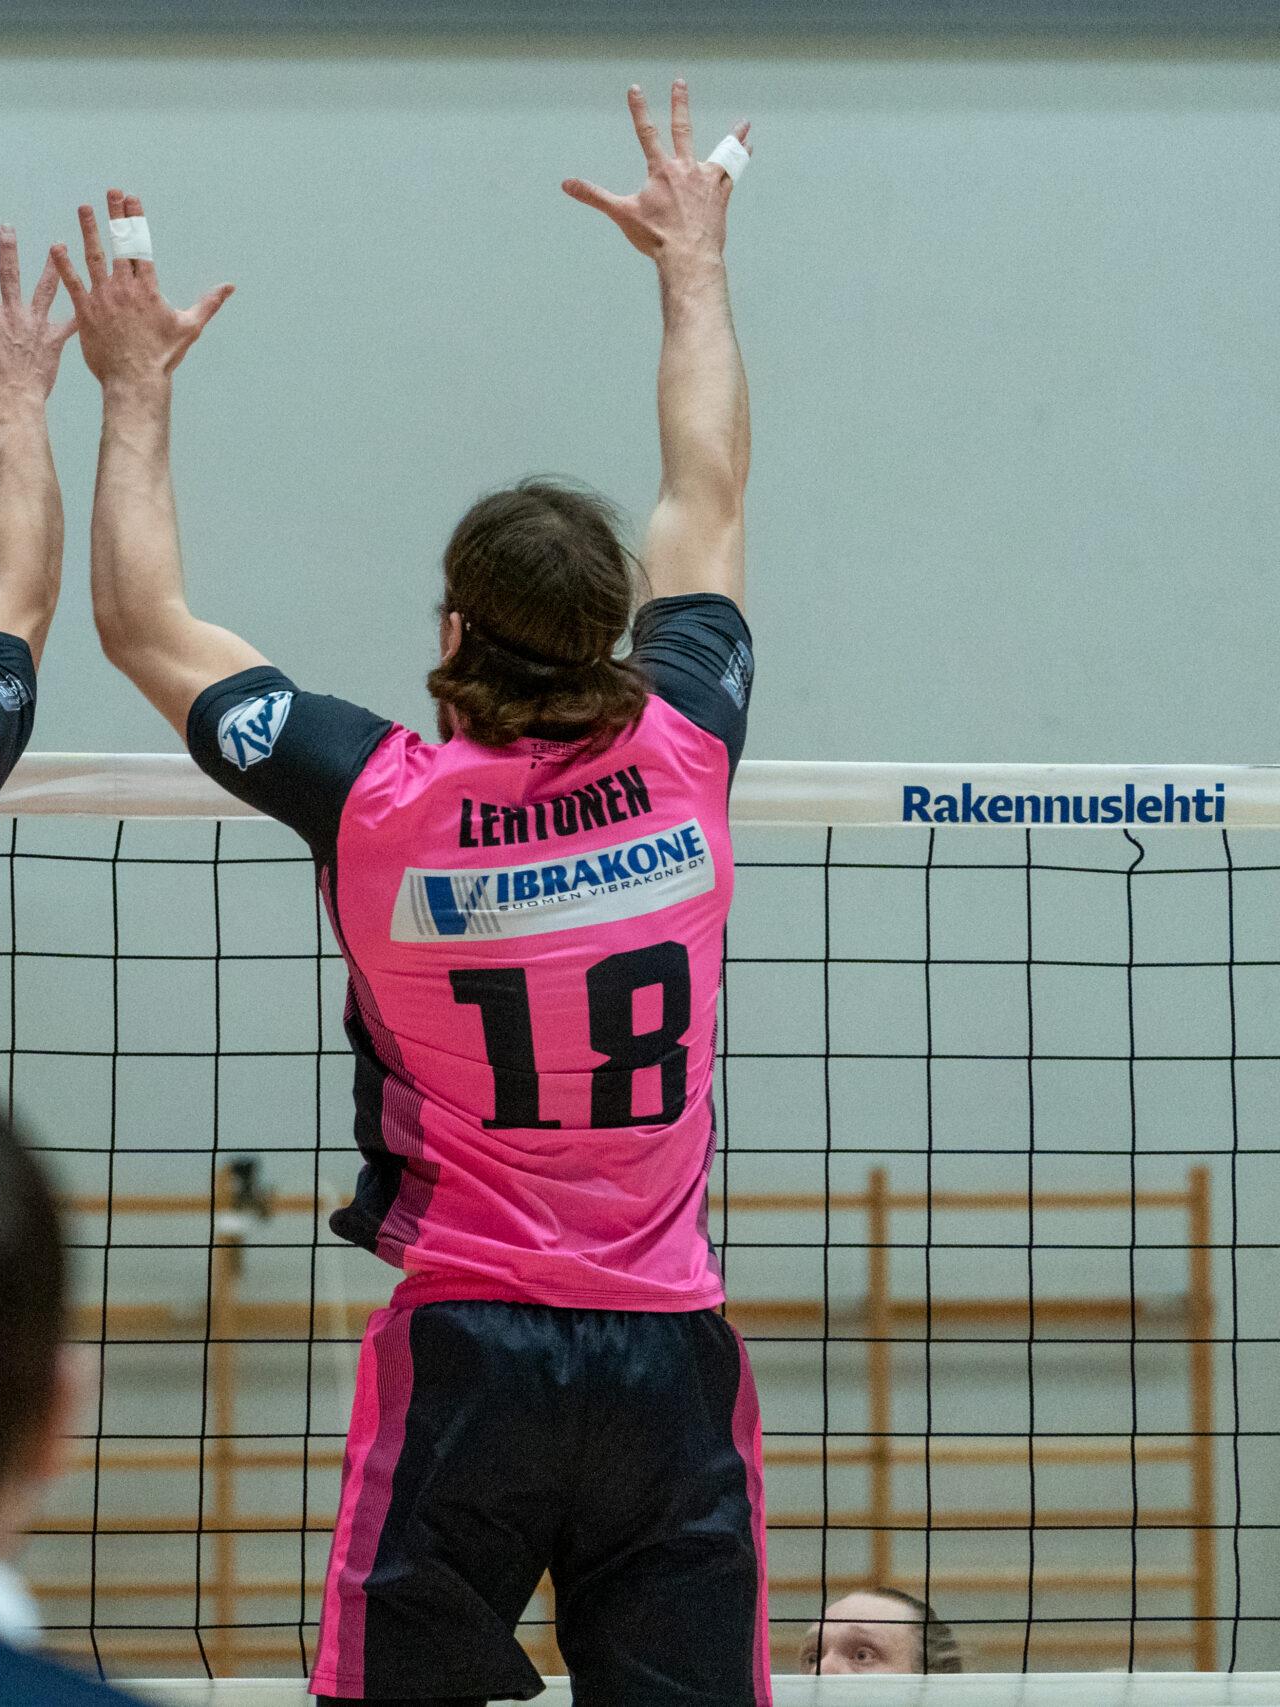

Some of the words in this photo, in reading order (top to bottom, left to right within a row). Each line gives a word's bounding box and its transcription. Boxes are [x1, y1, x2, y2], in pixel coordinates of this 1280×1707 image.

[459, 765, 652, 848] LEHTONEN
[902, 782, 1226, 824] Rakennuslehti
[499, 891, 582, 912] SUOMEN
[589, 865, 683, 896] VIBRAKONE
[689, 855, 706, 869] OY
[449, 940, 692, 1130] 18
